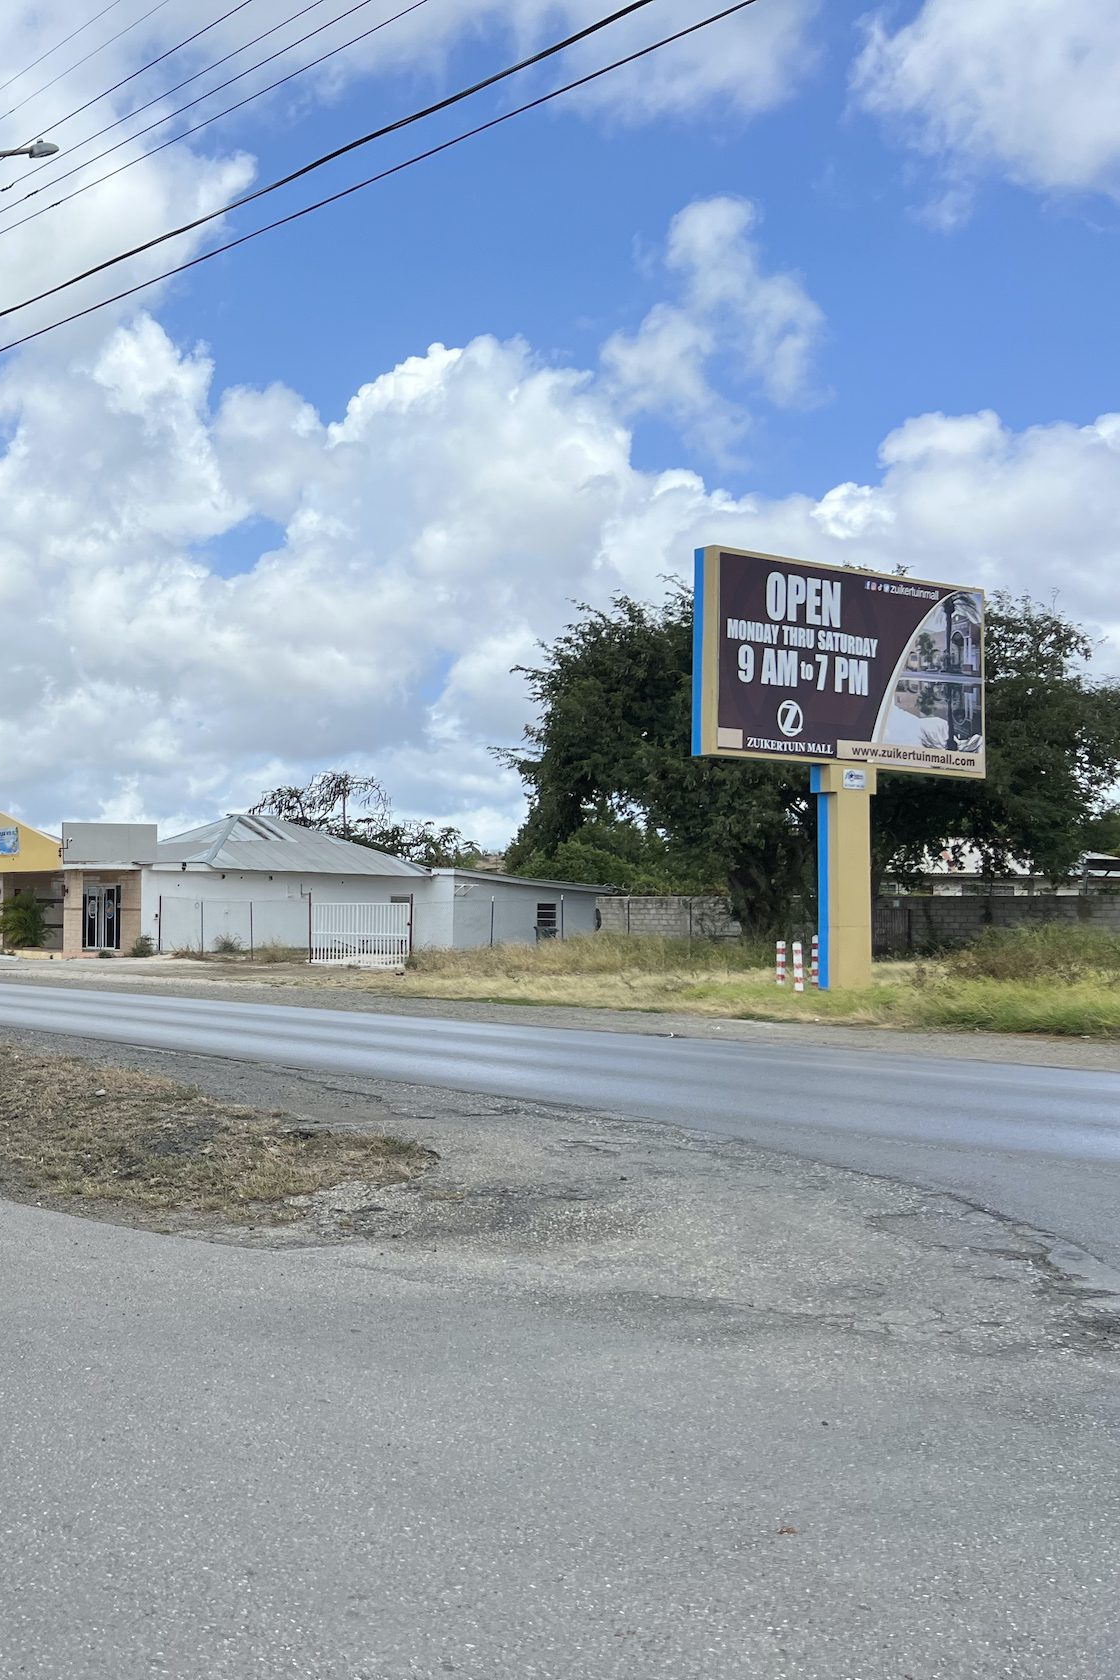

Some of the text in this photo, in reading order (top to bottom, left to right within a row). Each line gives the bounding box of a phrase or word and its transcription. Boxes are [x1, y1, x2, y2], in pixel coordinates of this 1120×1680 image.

[766, 571, 841, 628] OPEN
[890, 584, 939, 600] zuikertuinmall
[727, 618, 878, 658] MONDAY THRU SATURDAY
[737, 644, 868, 696] 9 AM to 7 PM
[746, 736, 834, 754] ZUIKERTUIN MALL
[851, 746, 976, 767] www.zuikertuinmall.com
